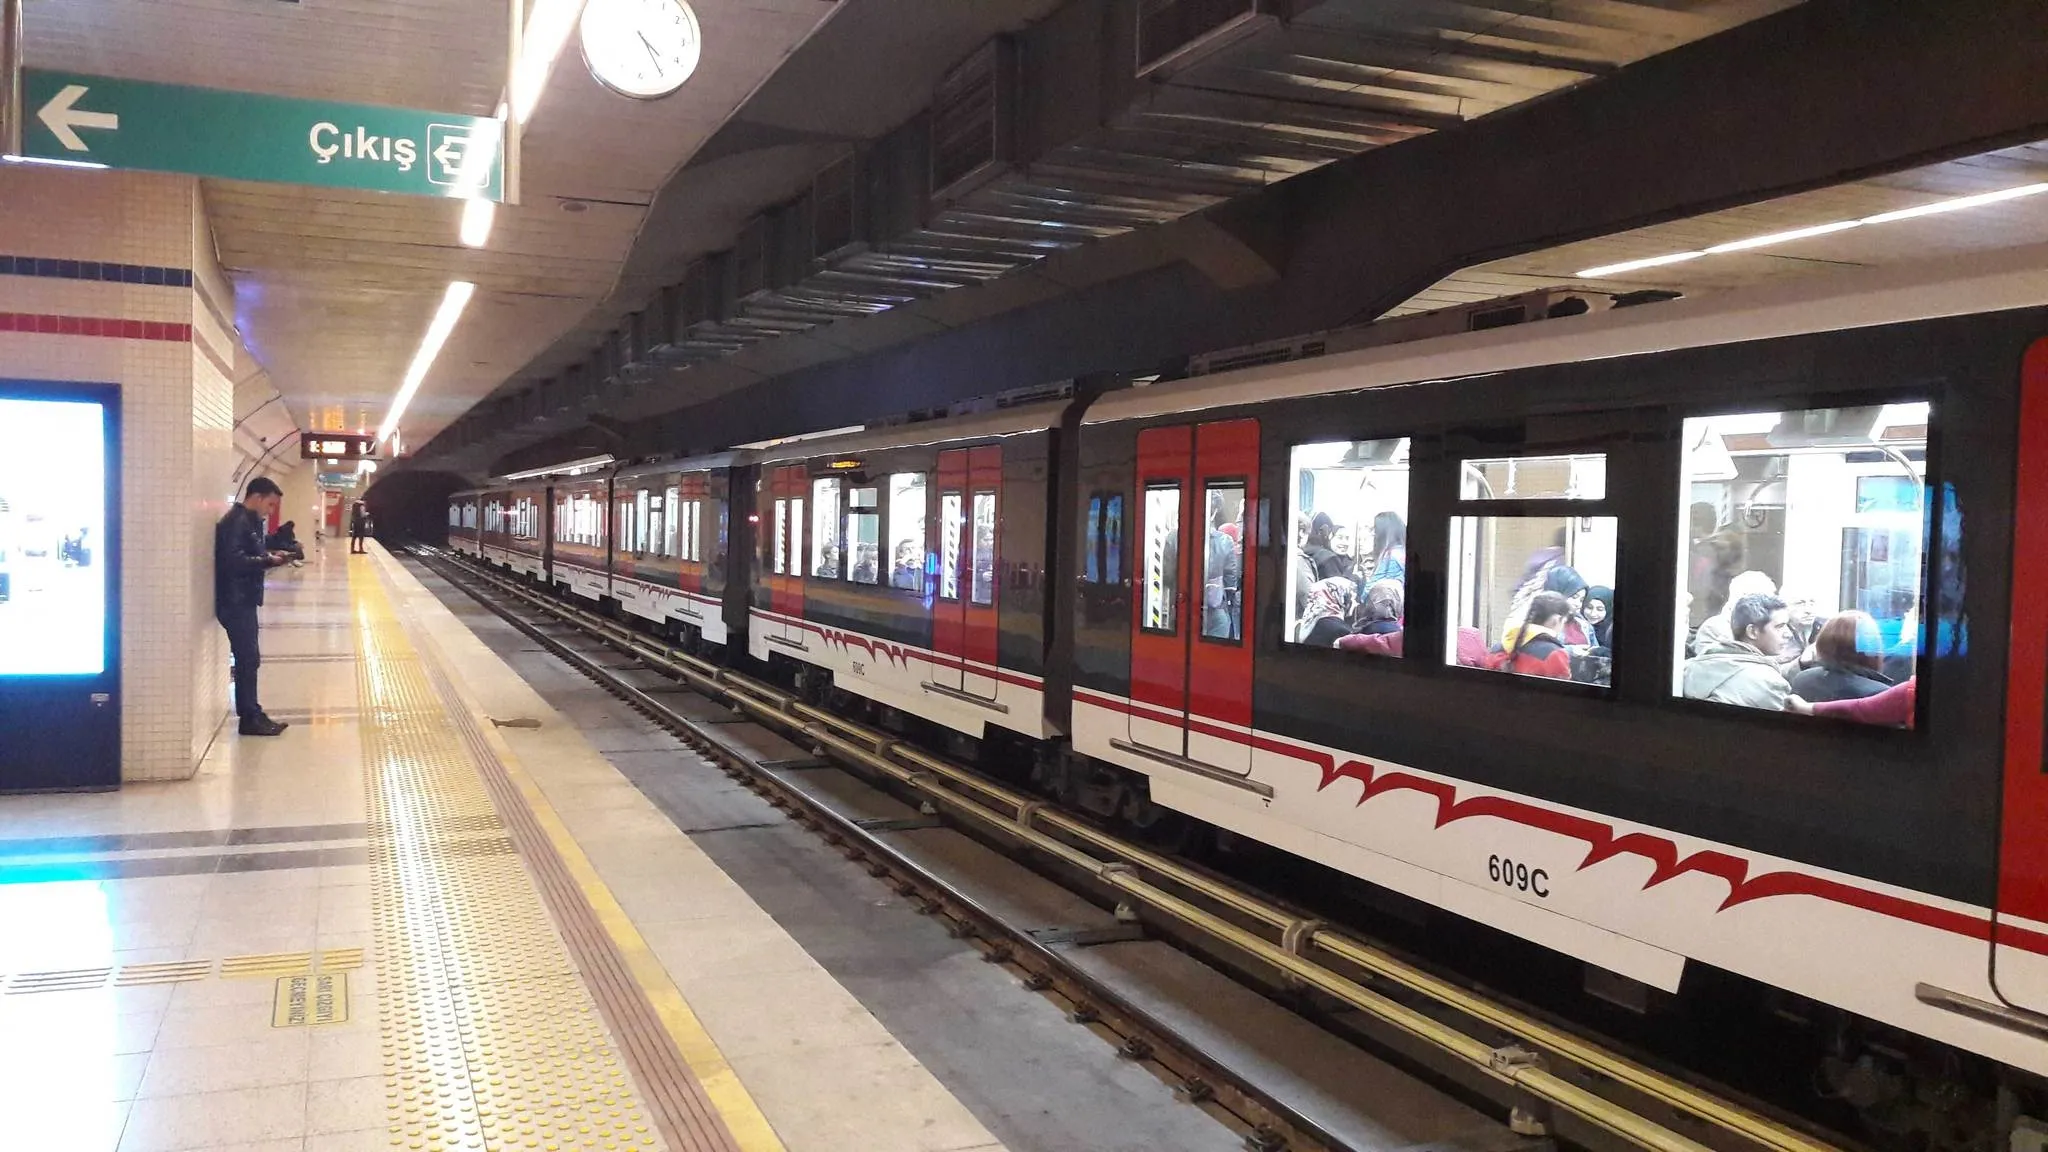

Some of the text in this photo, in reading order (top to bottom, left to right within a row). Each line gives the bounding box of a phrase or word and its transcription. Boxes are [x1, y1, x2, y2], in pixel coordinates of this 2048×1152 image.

[675, 15, 680, 24] 2
[309, 122, 417, 171] Çıkış
[1489, 854, 1550, 898] 609C
